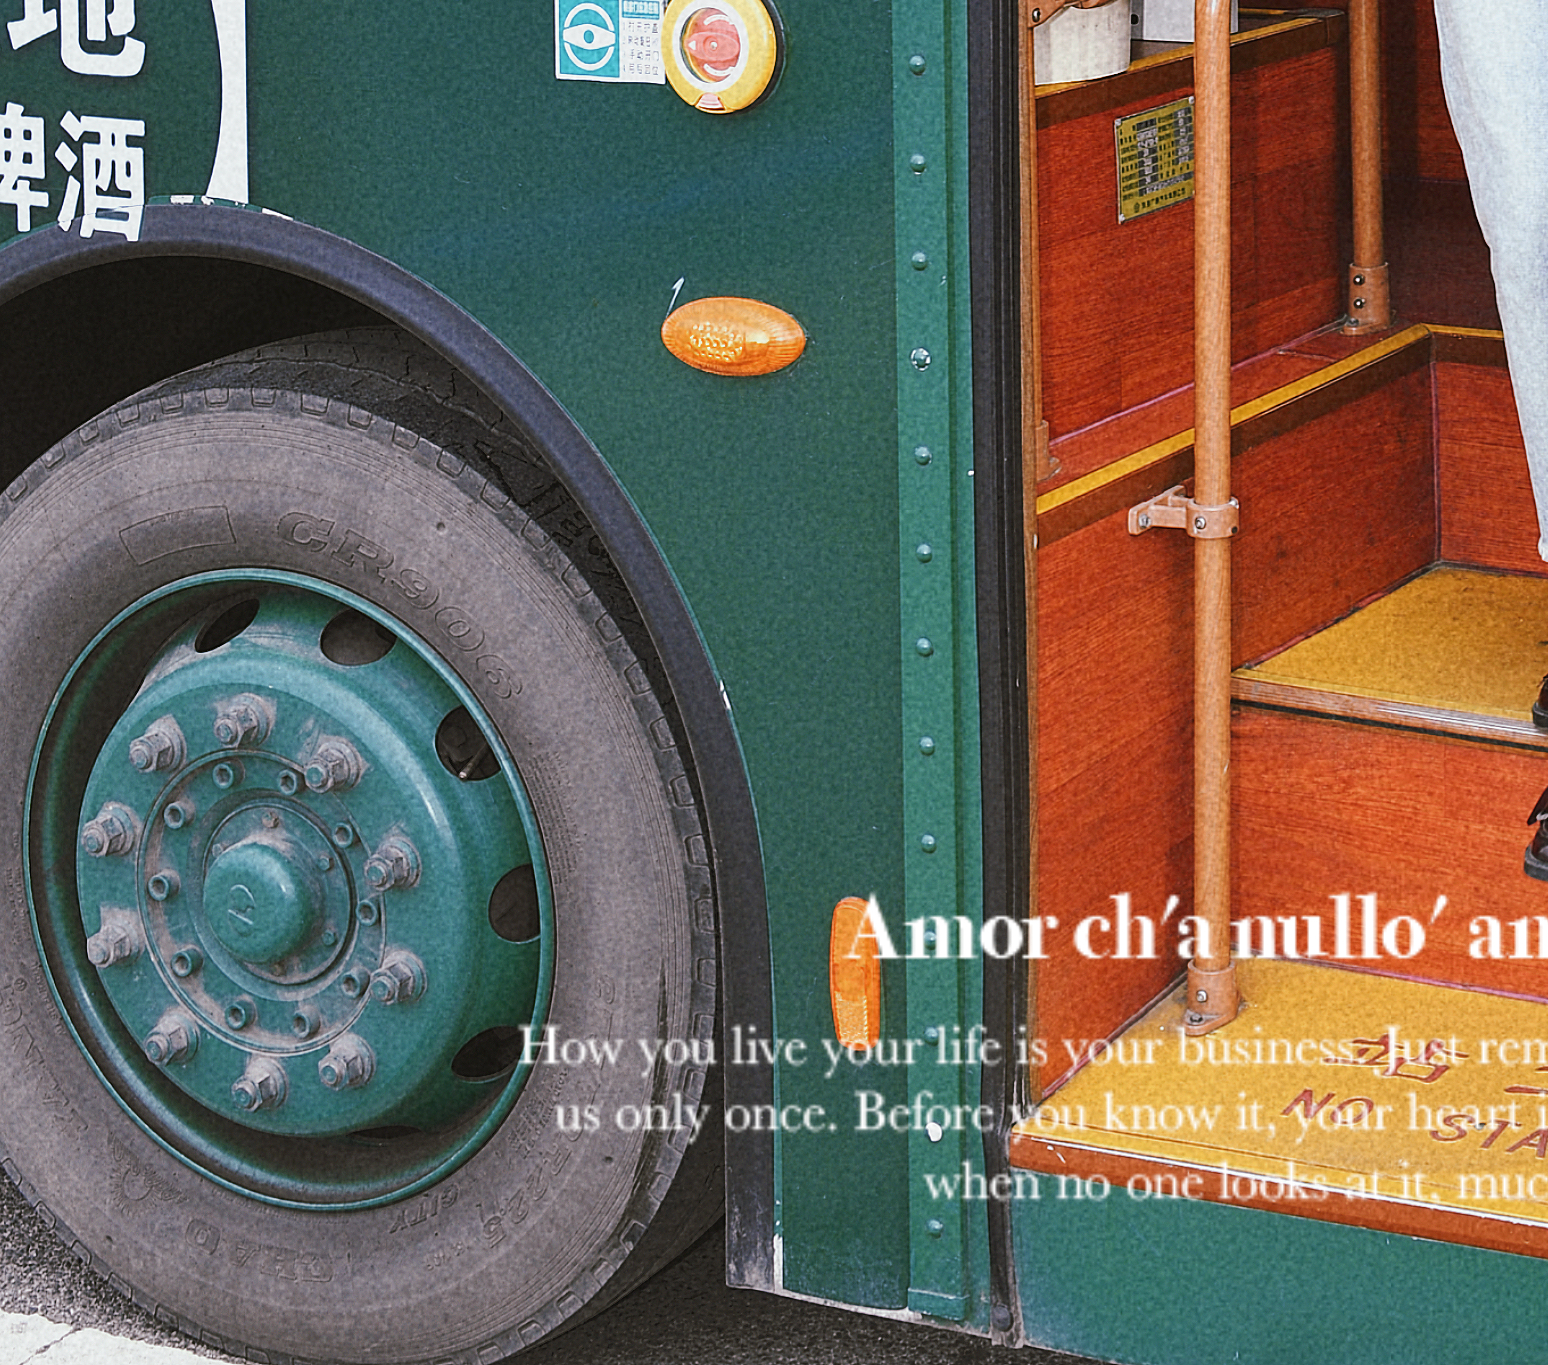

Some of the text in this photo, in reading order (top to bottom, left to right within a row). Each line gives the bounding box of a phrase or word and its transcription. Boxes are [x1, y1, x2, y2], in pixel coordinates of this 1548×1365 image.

[276, 510, 524, 699] CR906
[1281, 1087, 1375, 1124] NO
[388, 1181, 461, 1235] CITY
